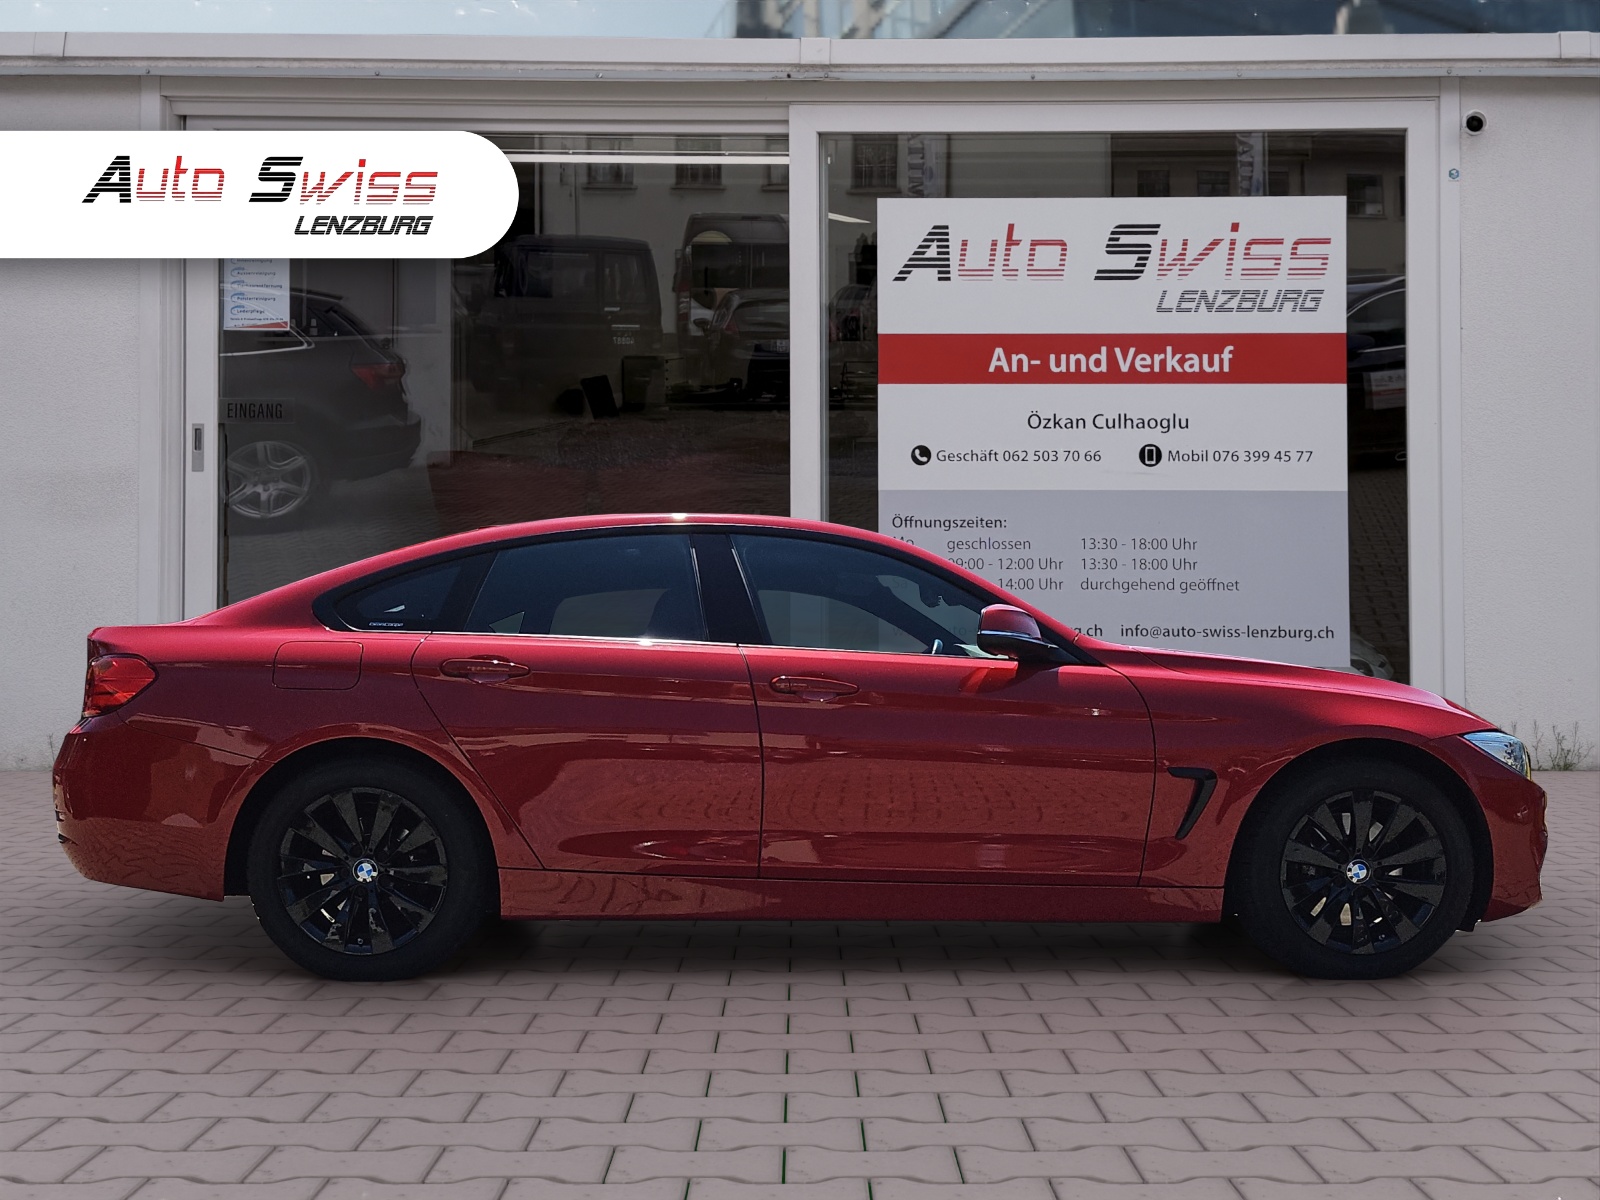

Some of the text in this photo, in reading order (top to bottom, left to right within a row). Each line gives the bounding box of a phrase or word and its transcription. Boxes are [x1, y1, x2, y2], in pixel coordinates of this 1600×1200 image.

[892, 222, 1332, 282] Auto Swiss
[1156, 290, 1325, 312] LENZBURG
[988, 345, 1235, 373] An- und Verkauf
[227, 403, 282, 419] EINGANG
[1027, 410, 1189, 434] Özkan Culhaoglu
[936, 449, 1102, 462] Geschäft 062 503 70 66
[1167, 449, 1314, 463] Mobil 076 399 45 77
[891, 514, 1007, 532] Öffnungszeiten:
[946, 537, 1031, 553] geschlossen
[1080, 538, 1118, 550] 13:30
[1131, 538, 1168, 550] 18:00
[1172, 538, 1198, 550] Uhr
[997, 558, 1035, 570] 12:00
[1038, 557, 1064, 570] Uhr
[1080, 558, 1118, 570] 13:30
[1131, 558, 1168, 571] 18:00
[1172, 558, 1198, 570] Uhr
[998, 578, 1035, 590] 14:00
[1038, 578, 1064, 590] Uhr
[1080, 578, 1175, 594] durchgehend
[1179, 578, 1240, 594] geöffnet
[1120, 624, 1335, 643] info@auto-swiss-lenzburg.ch
